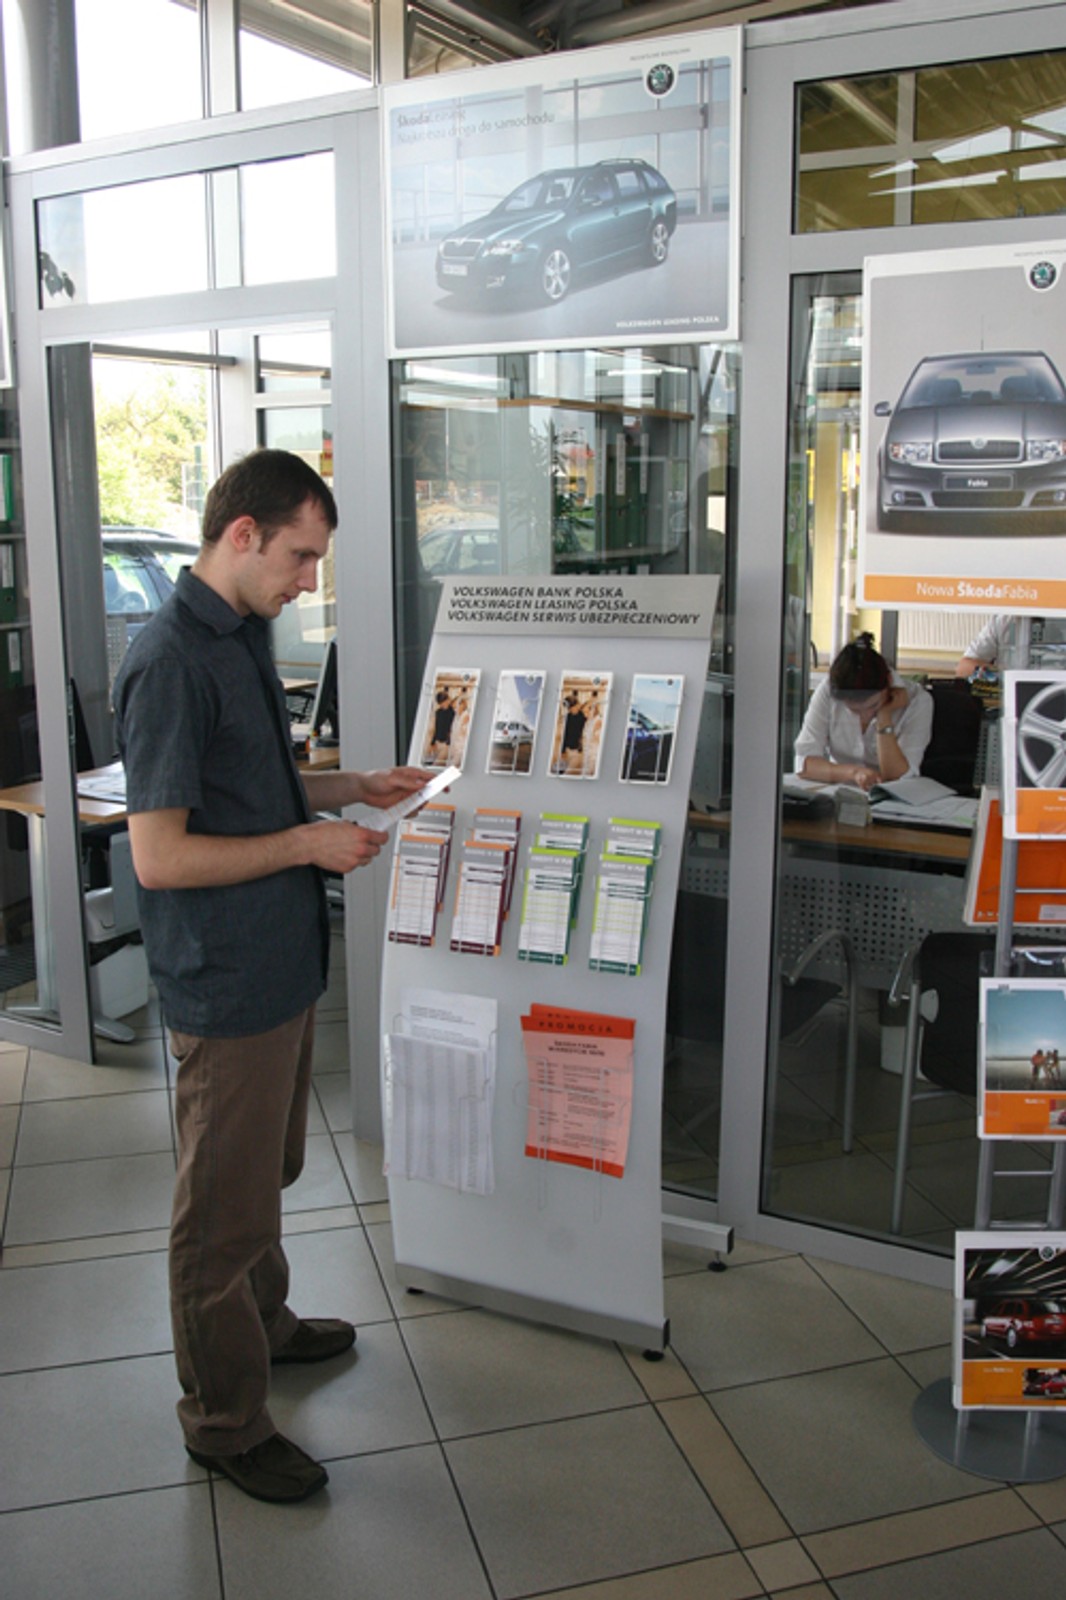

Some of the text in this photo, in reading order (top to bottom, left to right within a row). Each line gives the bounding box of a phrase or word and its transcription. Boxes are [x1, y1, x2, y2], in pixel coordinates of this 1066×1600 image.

[478, 120, 493, 132] do
[494, 111, 556, 129] samochodu
[453, 586, 624, 598] VOLKSWAGEN BANK POLSKA
[916, 582, 955, 597] Nowa
[450, 599, 639, 611] VOLKSWAGEN LEASING POLSKA
[447, 610, 701, 624] VOLKSWAGEN SERWIS UBEZPIECZENIOWY
